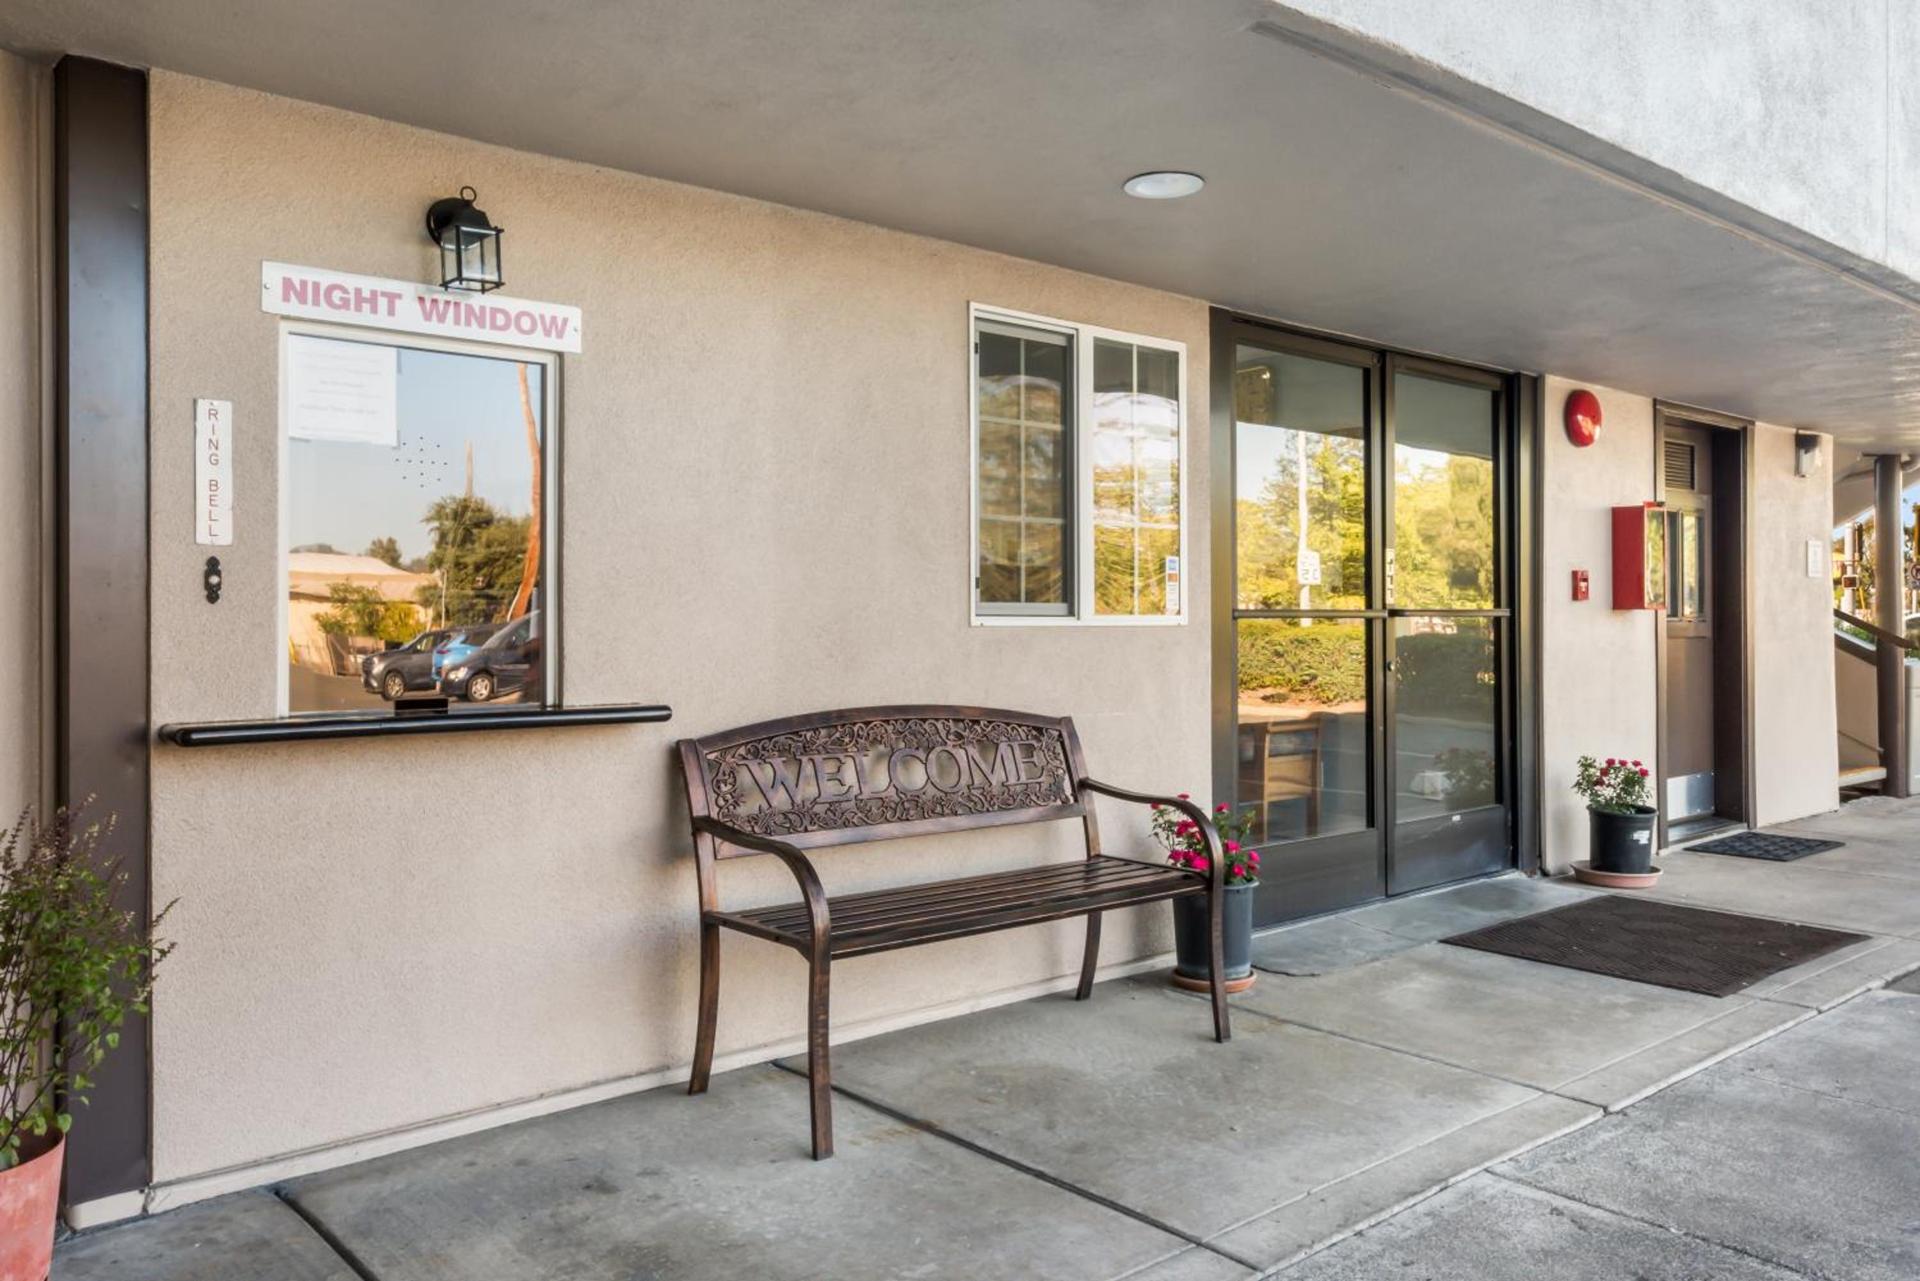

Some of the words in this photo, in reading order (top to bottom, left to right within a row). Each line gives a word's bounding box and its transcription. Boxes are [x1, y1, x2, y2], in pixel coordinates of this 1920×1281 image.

[281, 276, 403, 318] NIGHT
[416, 296, 570, 340] WINDOW
[208, 408, 220, 467] RING
[208, 479, 220, 537] BELL
[735, 740, 1047, 809] WELCOME
